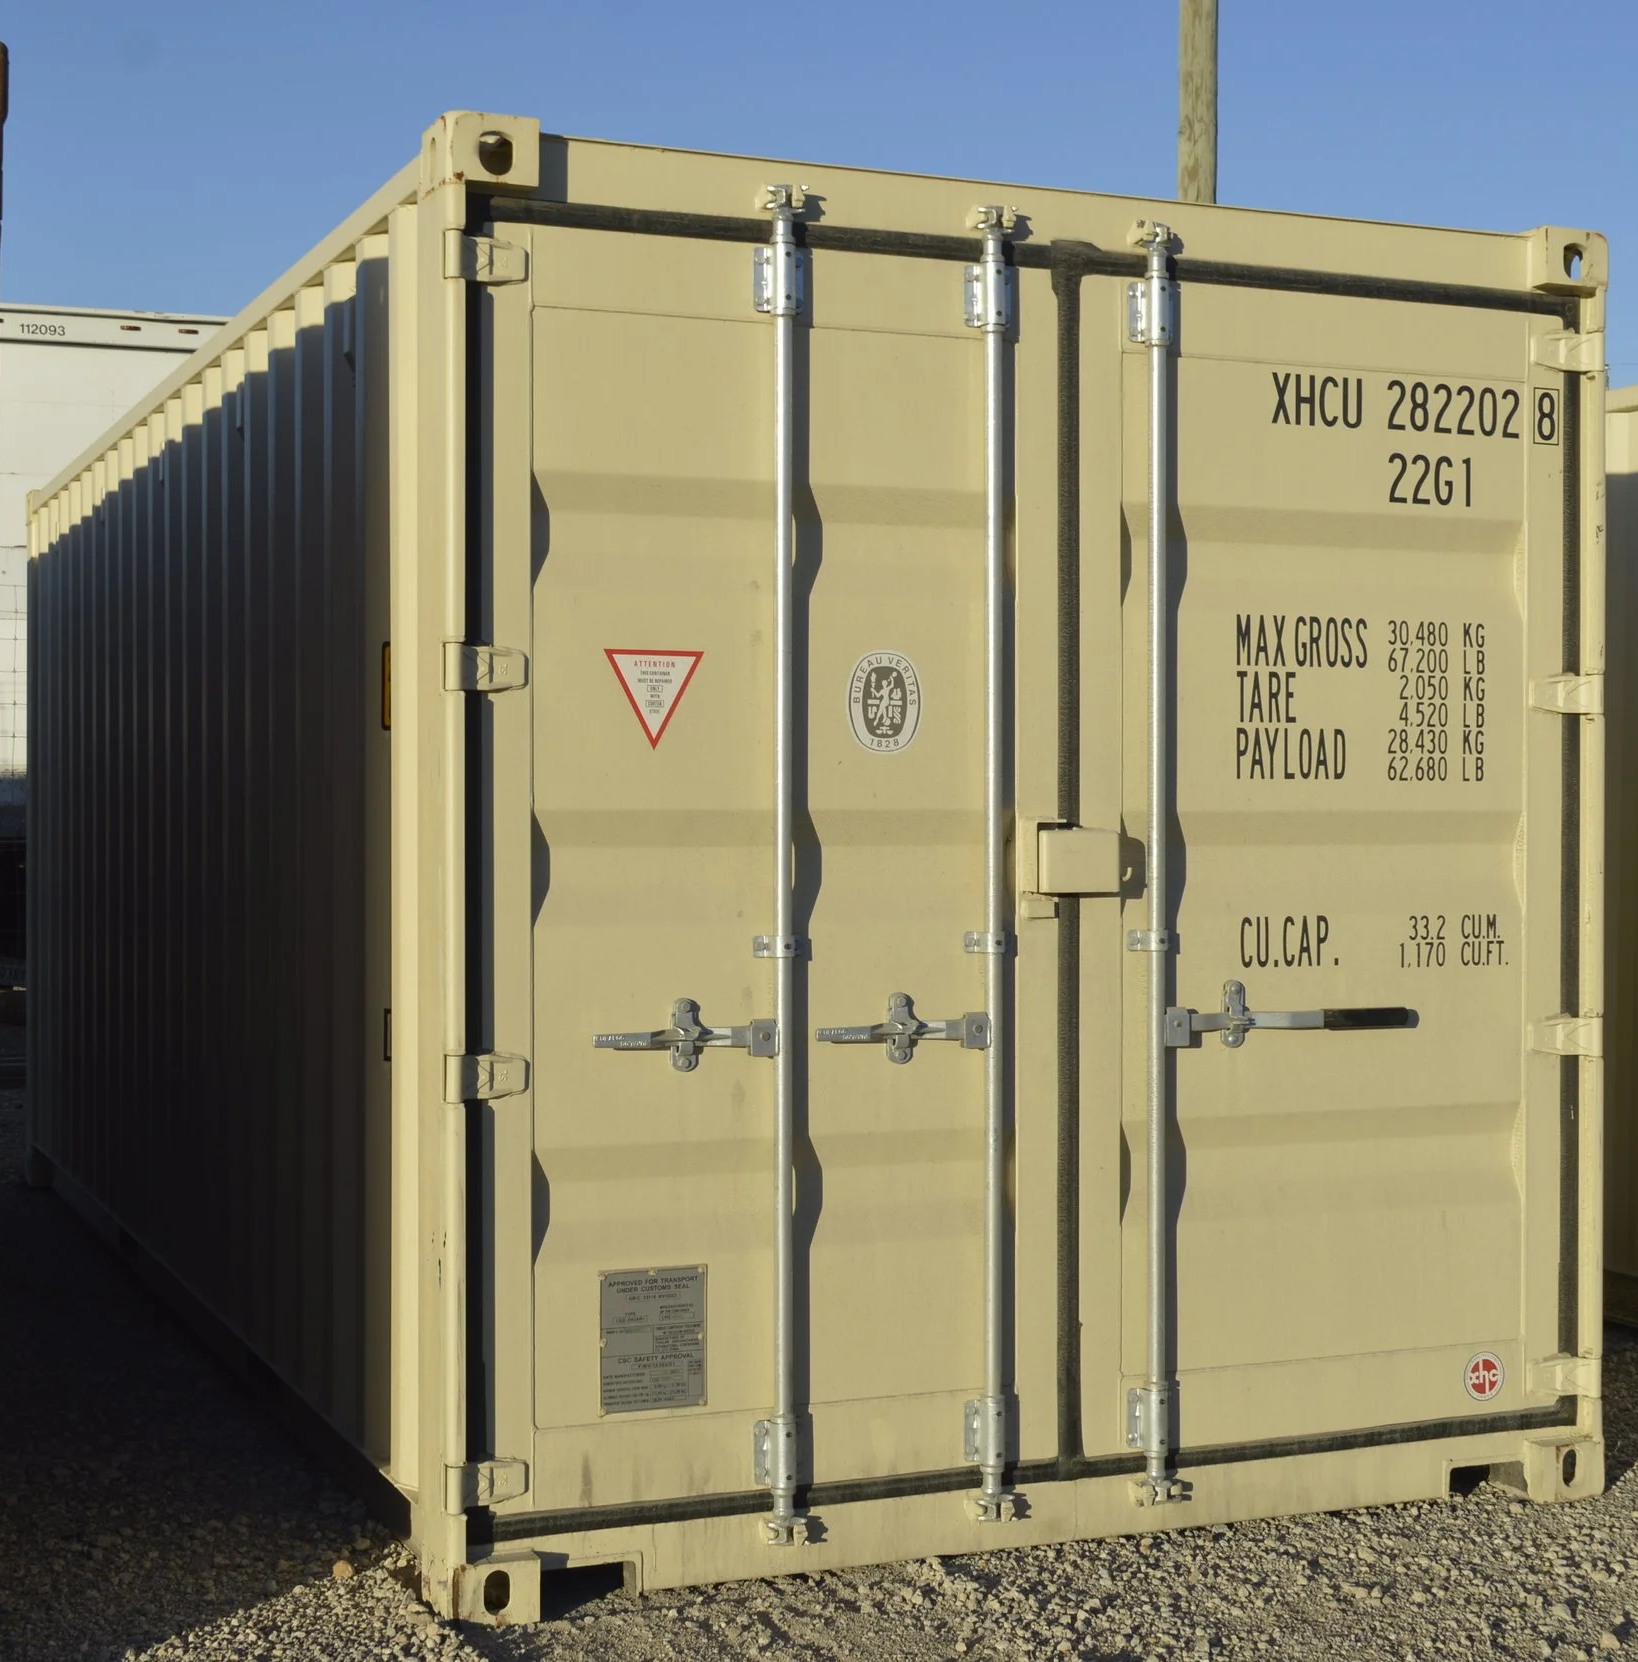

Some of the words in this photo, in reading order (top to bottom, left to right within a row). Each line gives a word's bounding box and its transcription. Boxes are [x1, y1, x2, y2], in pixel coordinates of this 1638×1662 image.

[19, 323, 65, 336] 112093
[1271, 371, 1363, 429] XHCU
[1387, 379, 1521, 439] 282202
[1537, 391, 1556, 441] 8
[1388, 452, 1472, 508] 22G1
[1236, 613, 1286, 667] MAX
[1294, 615, 1368, 669] GROSS
[1387, 620, 1448, 647] 30,480
[1462, 622, 1485, 648] KG
[634, 660, 676, 668] ATTENTION
[1387, 647, 1449, 674] 67,200
[1462, 649, 1485, 675] LB
[852, 656, 883, 704] BUREAU
[887, 656, 917, 706] VERITAS
[1399, 675, 1449, 701] 2,050
[1462, 676, 1485, 702] KG
[1236, 670, 1297, 724] TARE
[1399, 702, 1448, 728] 4,520
[1462, 703, 1485, 729] LB
[870, 738, 900, 748] 1828
[1236, 727, 1346, 780] PAYLOAD
[1387, 729, 1448, 755] 28,430
[1462, 730, 1484, 755] KG
[1387, 756, 1448, 782] 62,680
[1462, 757, 1484, 782] LB
[1409, 915, 1446, 941] 33.2
[1399, 942, 1446, 968] 1,170
[674, 1282, 690, 1290] SEAL
